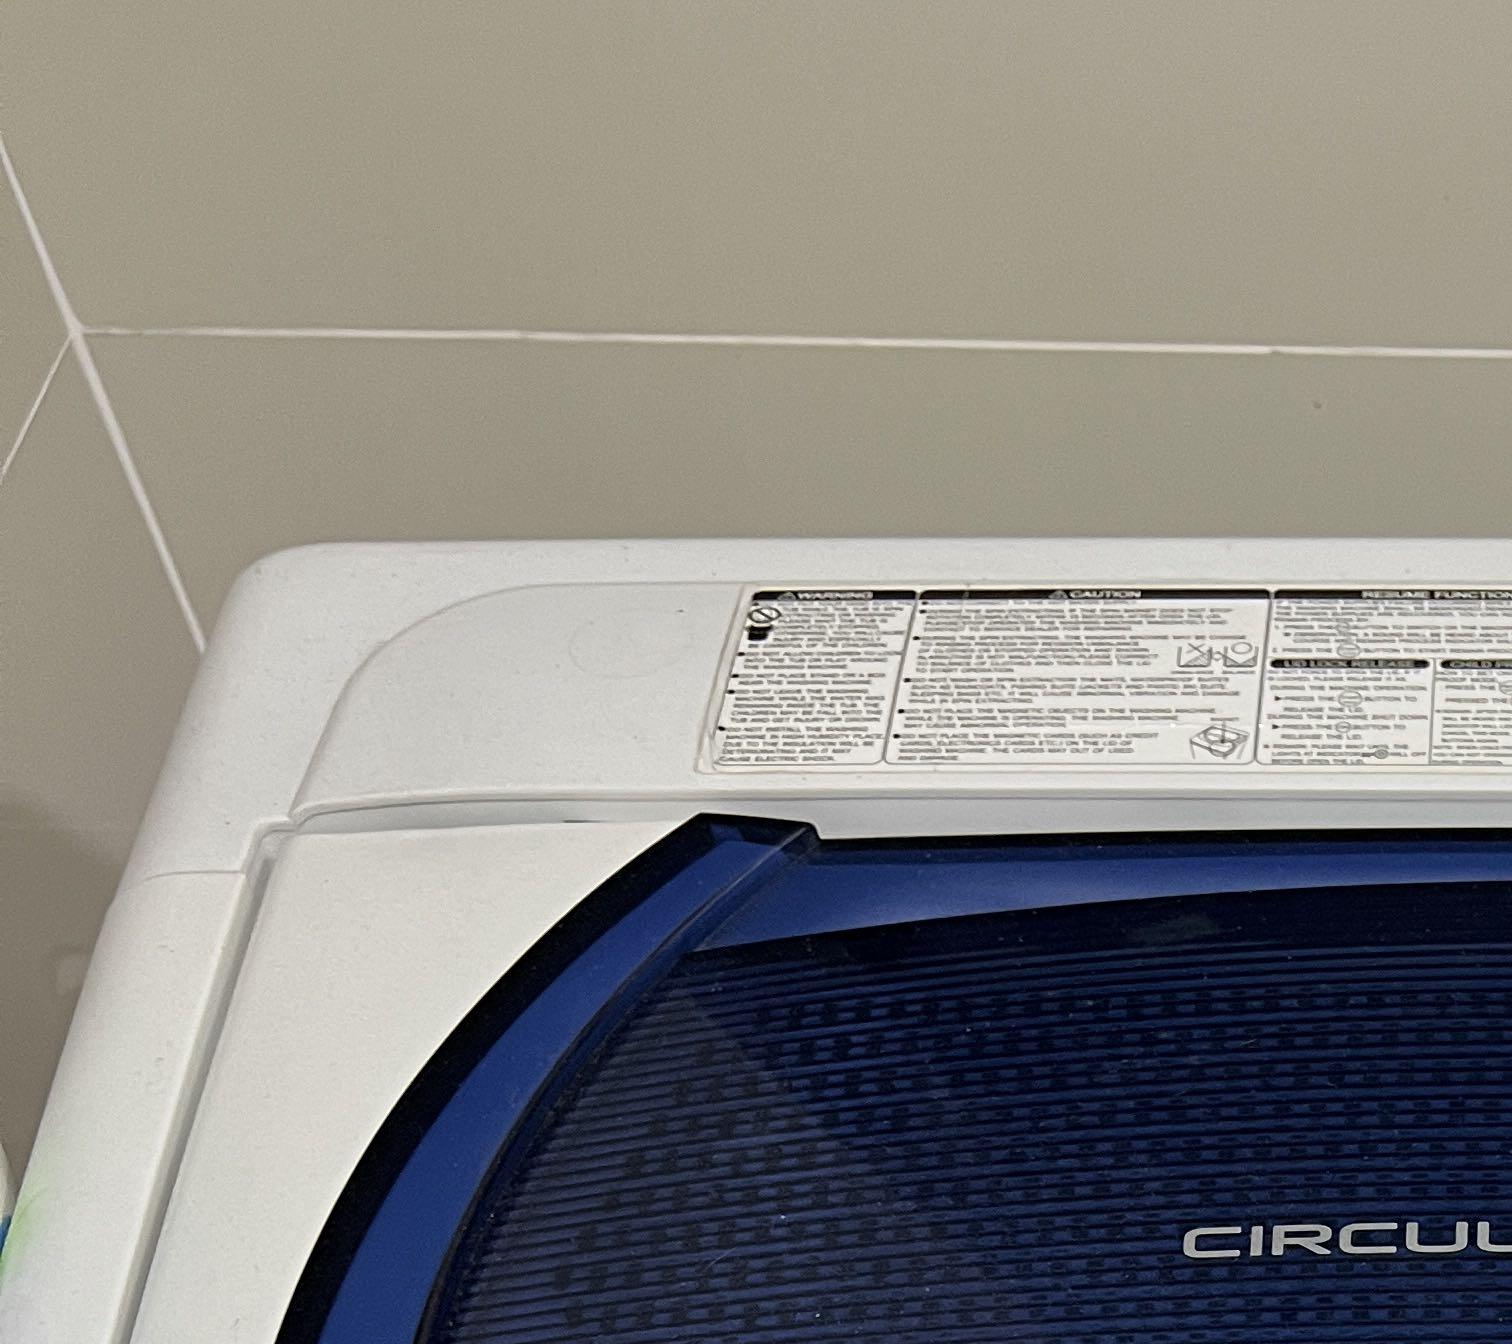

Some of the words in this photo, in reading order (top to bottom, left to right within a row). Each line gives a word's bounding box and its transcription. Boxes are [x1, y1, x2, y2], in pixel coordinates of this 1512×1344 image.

[797, 591, 873, 600] WARNING
[1069, 591, 1142, 599] CAUTION
[1361, 590, 1431, 599] RESUME
